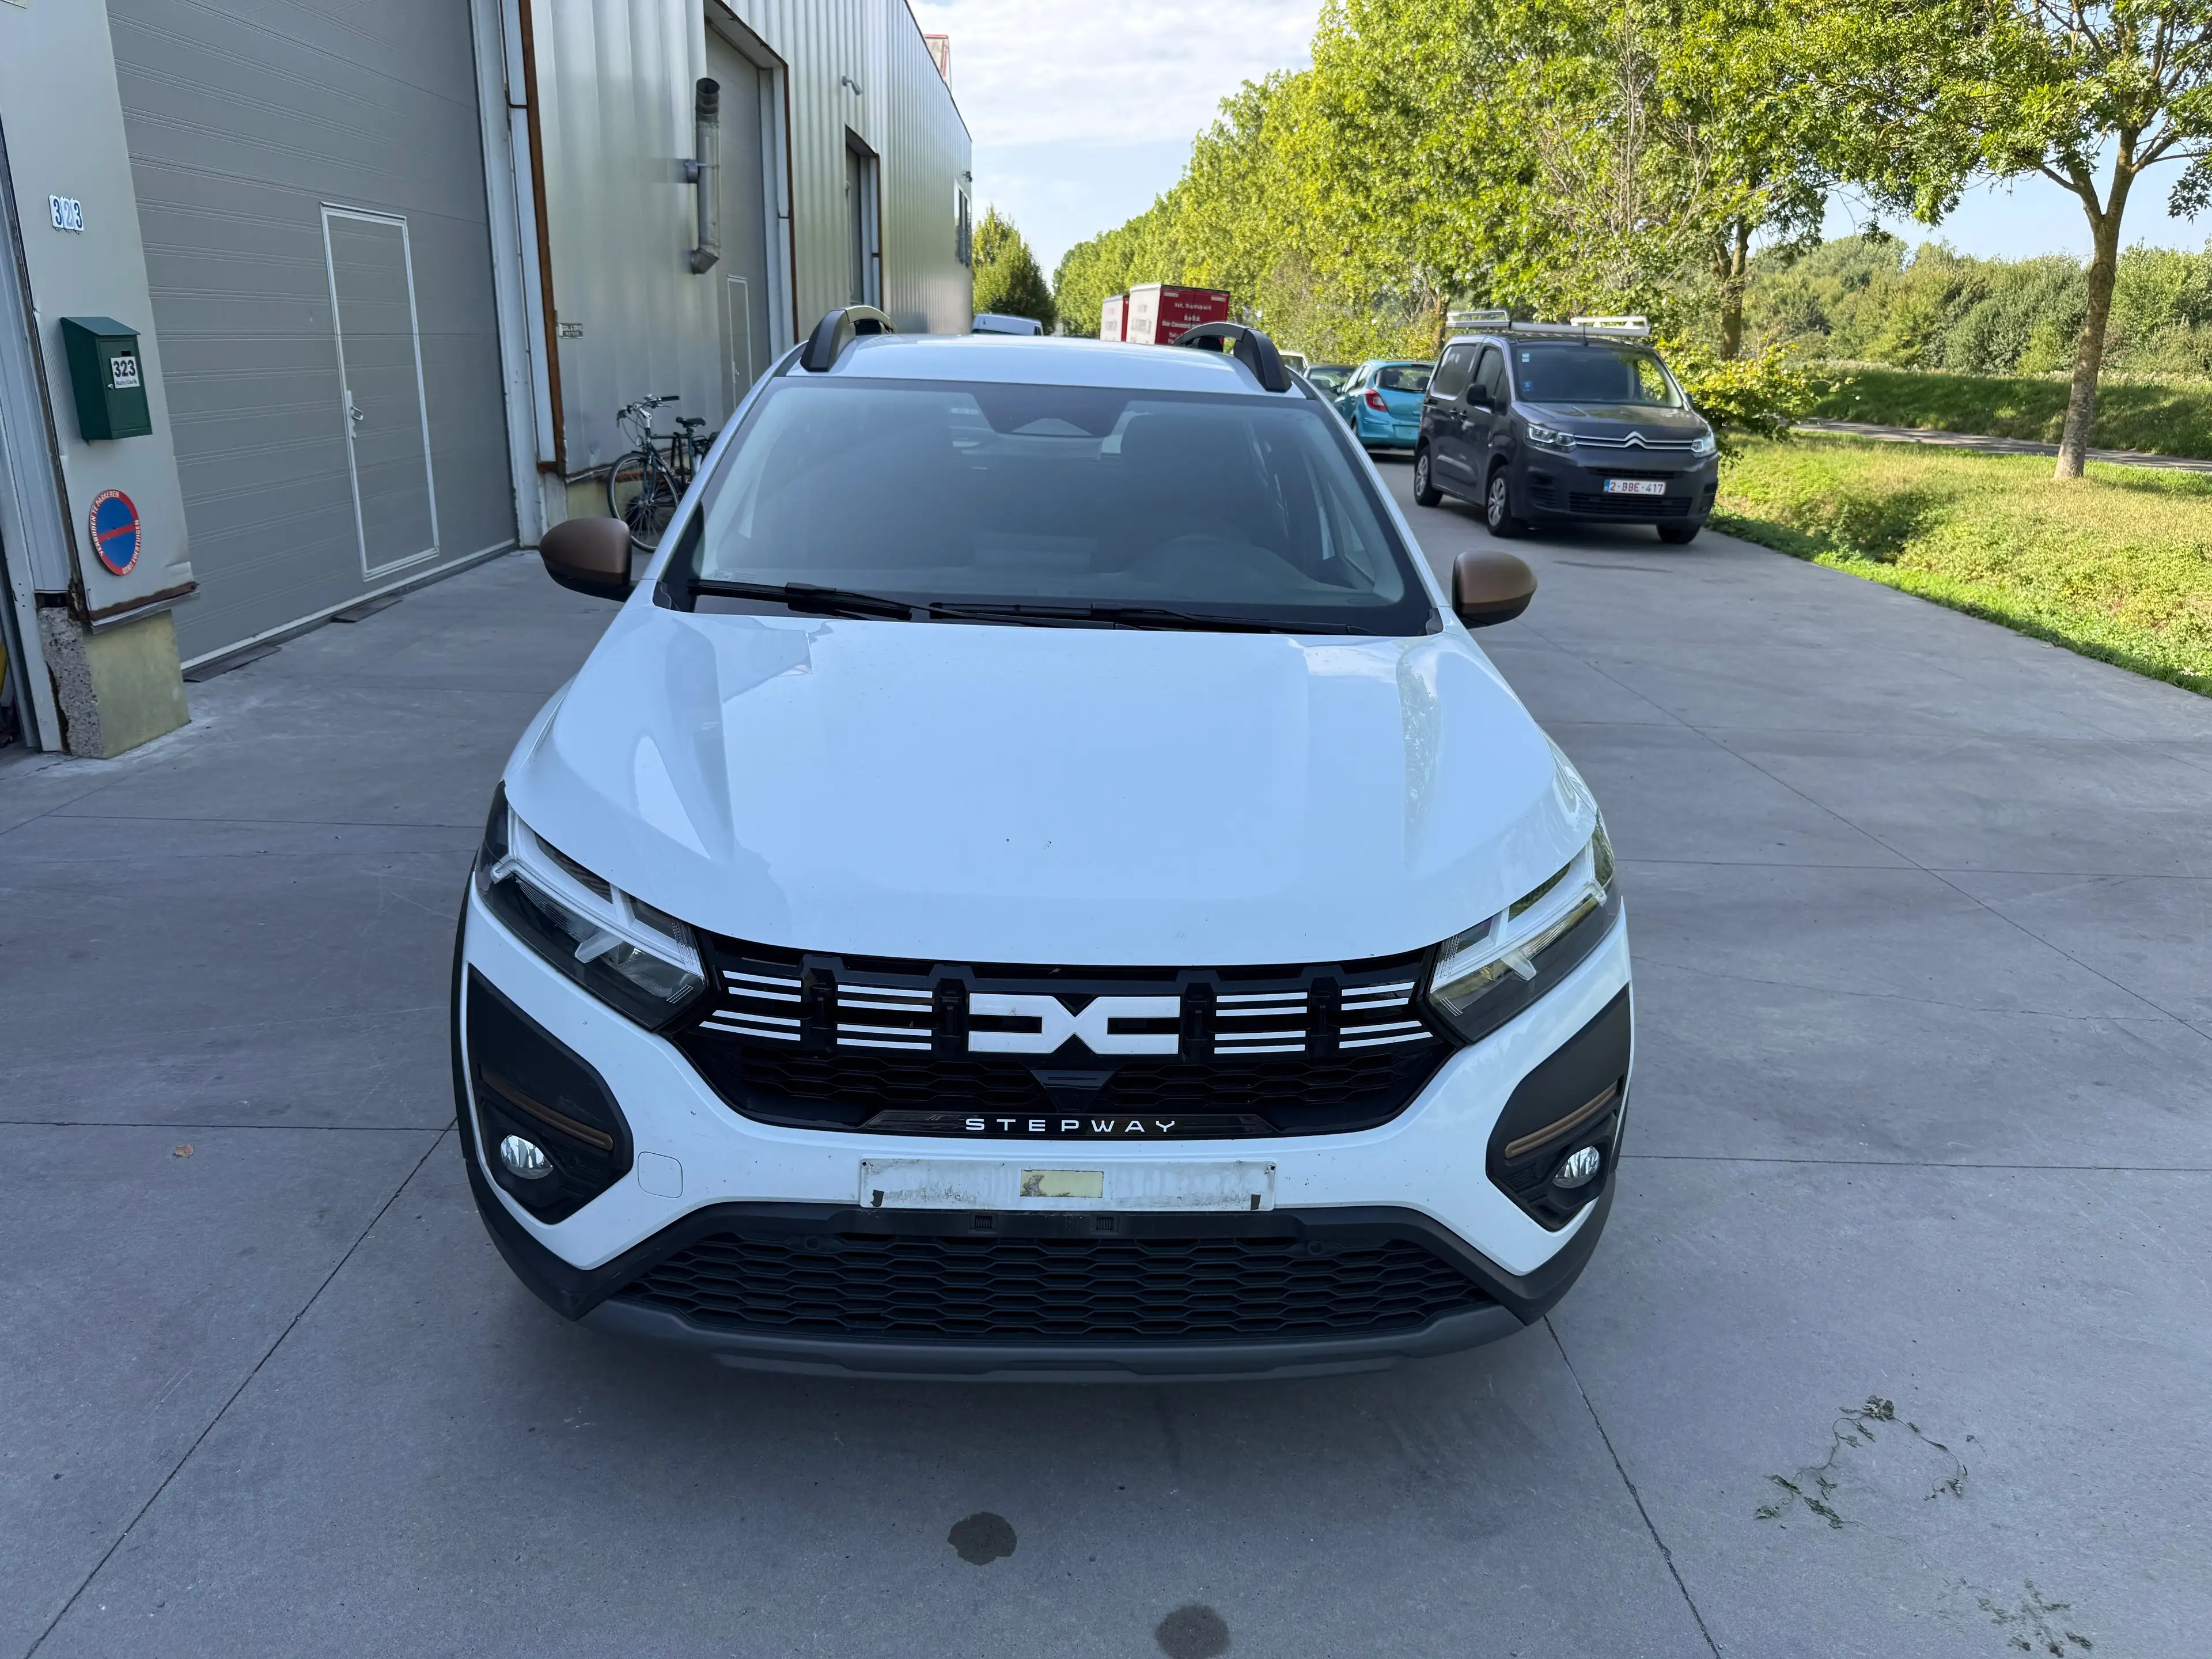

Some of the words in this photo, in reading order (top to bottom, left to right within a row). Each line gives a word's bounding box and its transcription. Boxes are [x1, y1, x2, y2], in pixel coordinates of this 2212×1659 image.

[54, 198, 82, 228] 323
[113, 359, 135, 378] 323
[96, 490, 119, 507] PARKEREN
[92, 505, 98, 514] TE
[91, 515, 104, 556] VERBODEN
[965, 1118, 1176, 1133] STEPWAY
